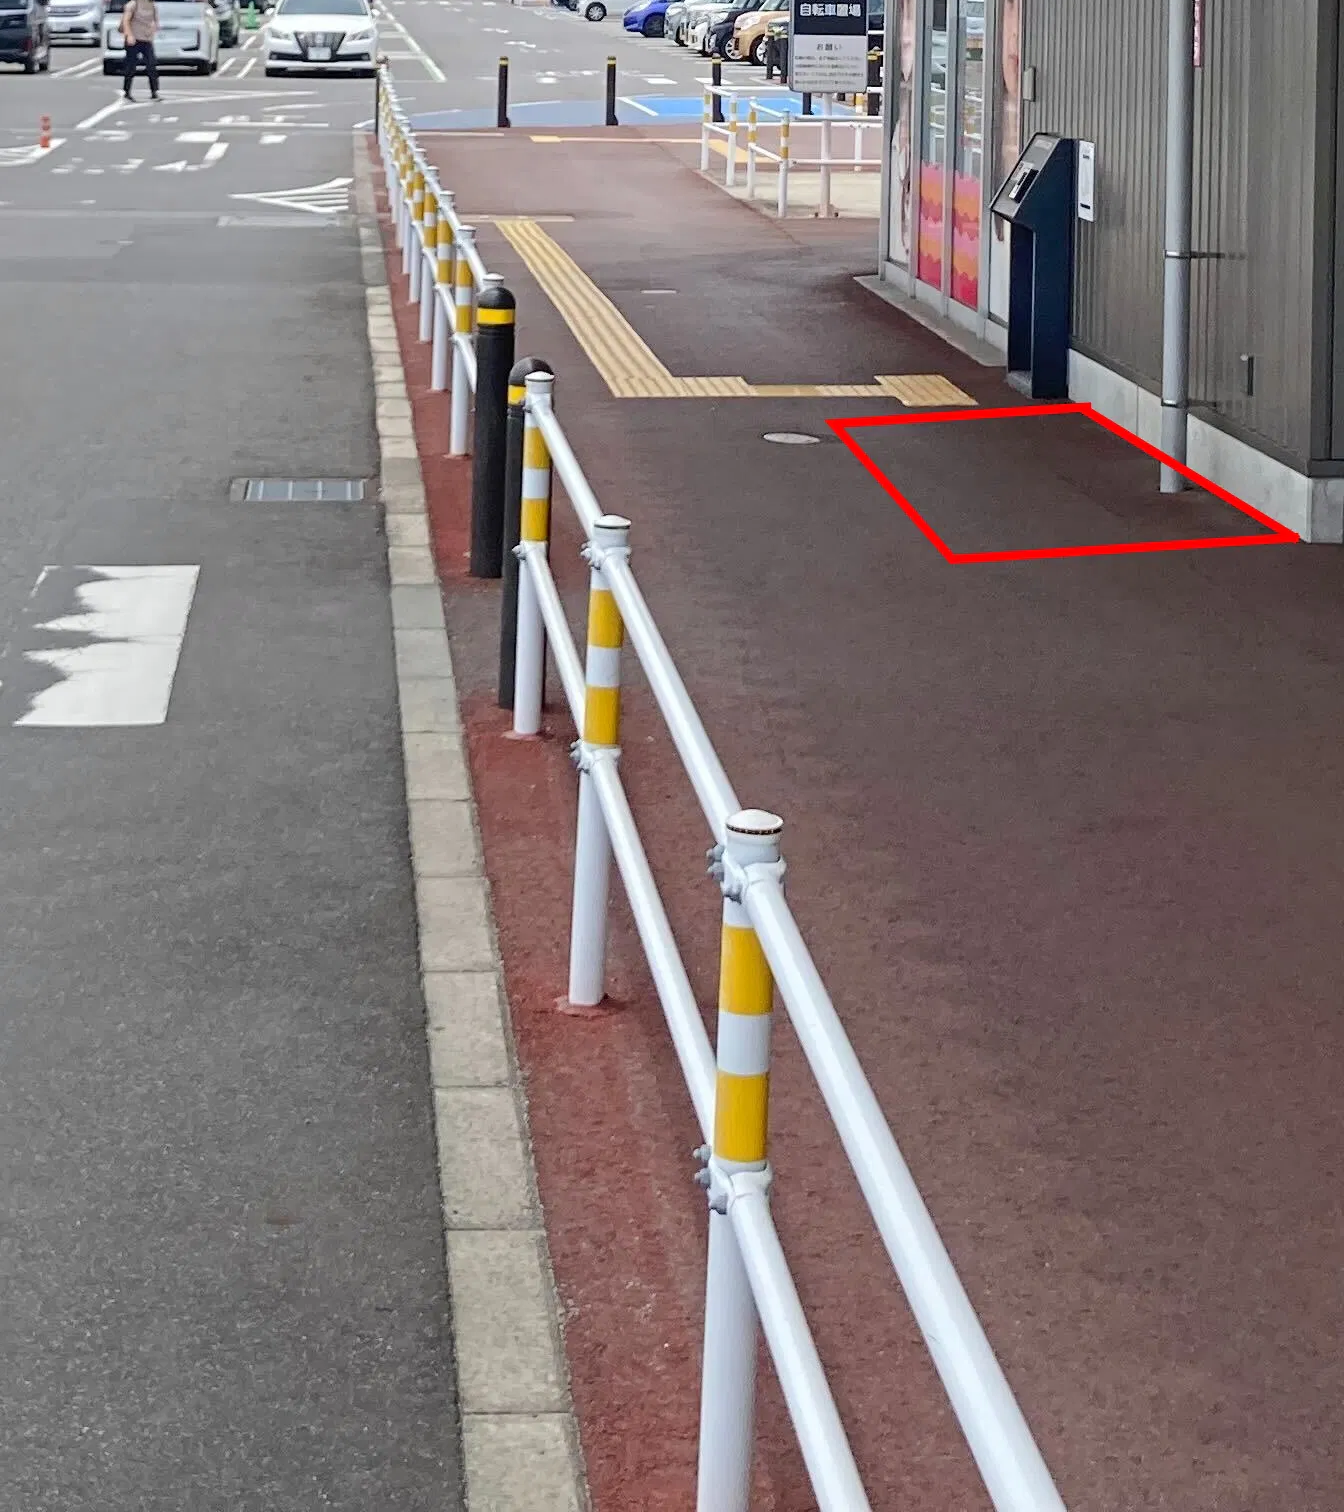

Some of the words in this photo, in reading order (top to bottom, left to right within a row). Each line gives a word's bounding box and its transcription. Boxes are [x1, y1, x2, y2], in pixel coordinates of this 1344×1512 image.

[799, 3, 862, 17] 自転車置場
